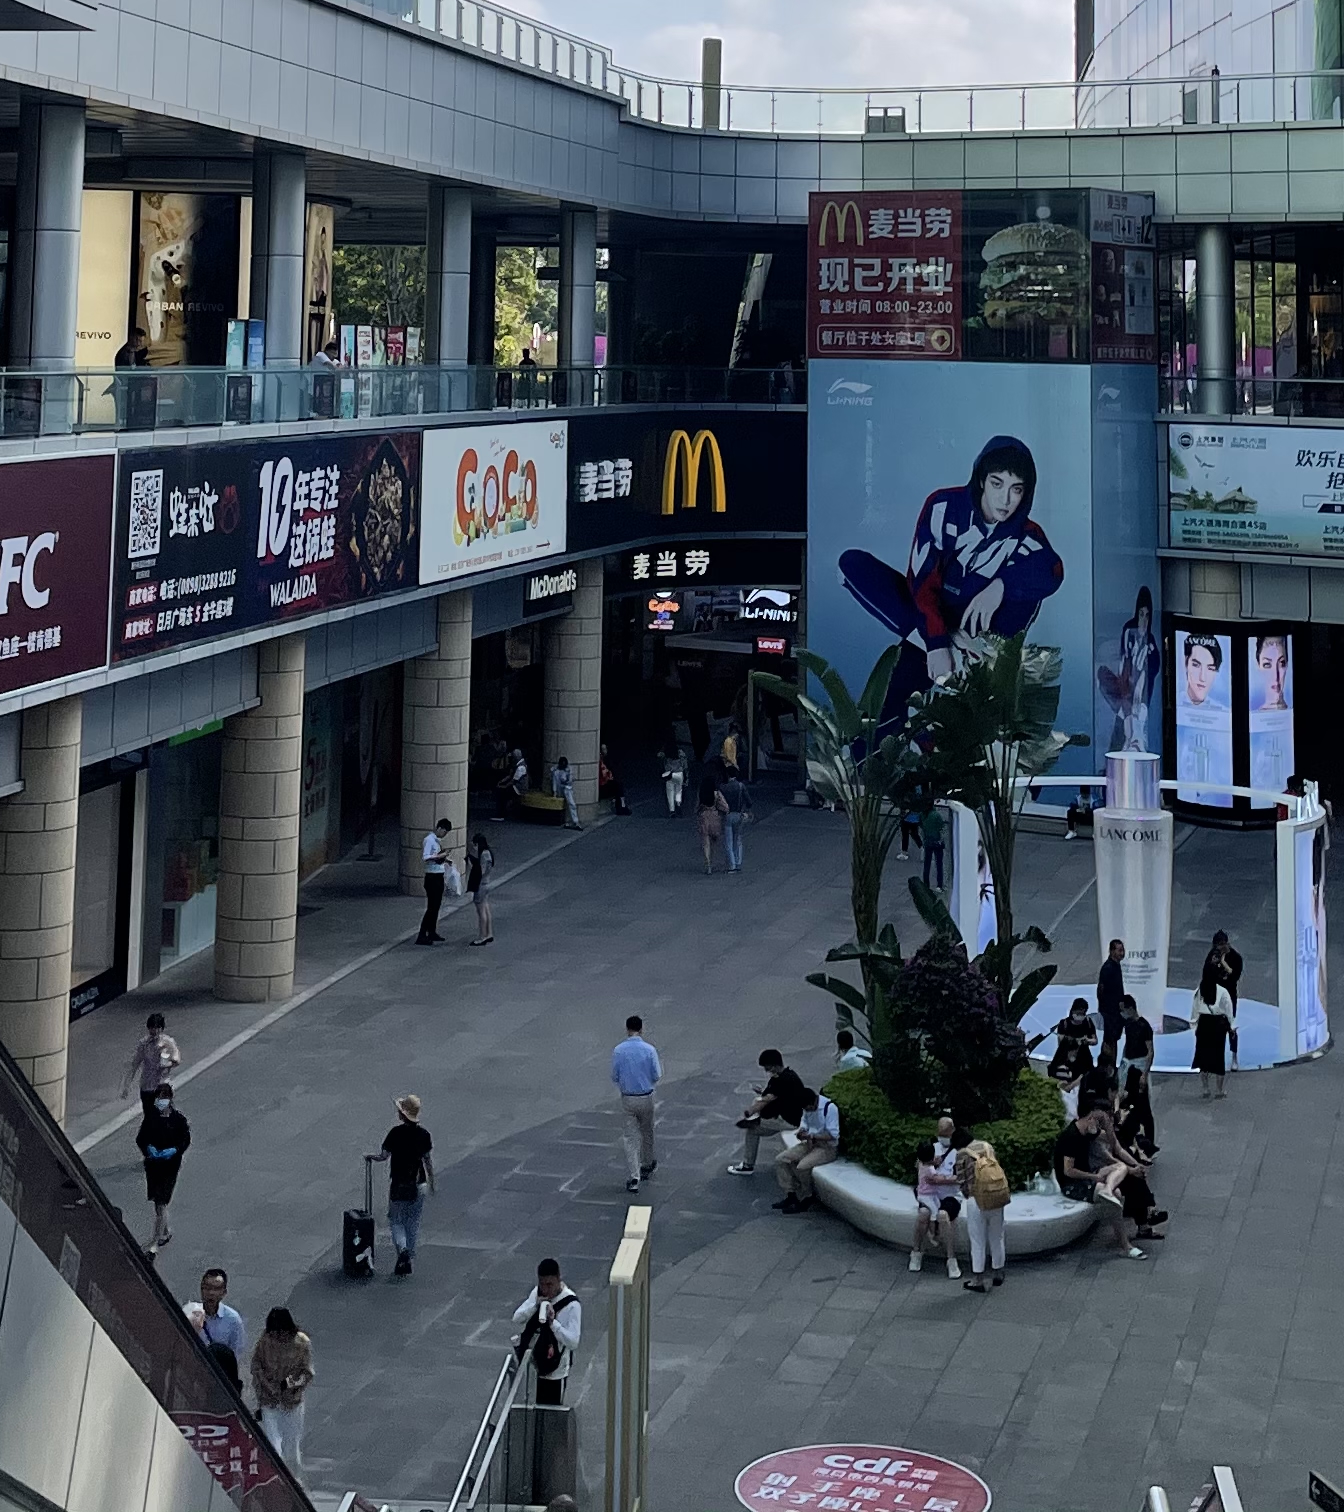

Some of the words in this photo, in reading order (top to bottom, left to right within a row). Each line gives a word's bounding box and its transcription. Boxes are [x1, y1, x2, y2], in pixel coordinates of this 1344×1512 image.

[868, 208, 952, 238] 麦当劳
[819, 257, 953, 295] 现已开业
[820, 299, 871, 314] 营业时间
[578, 458, 633, 502] 麦当劳
[633, 550, 710, 579] 麦当劳
[270, 573, 317, 608] WALAIDA
[530, 569, 577, 601] McDonald's
[823, 1454, 914, 1477] cdf
